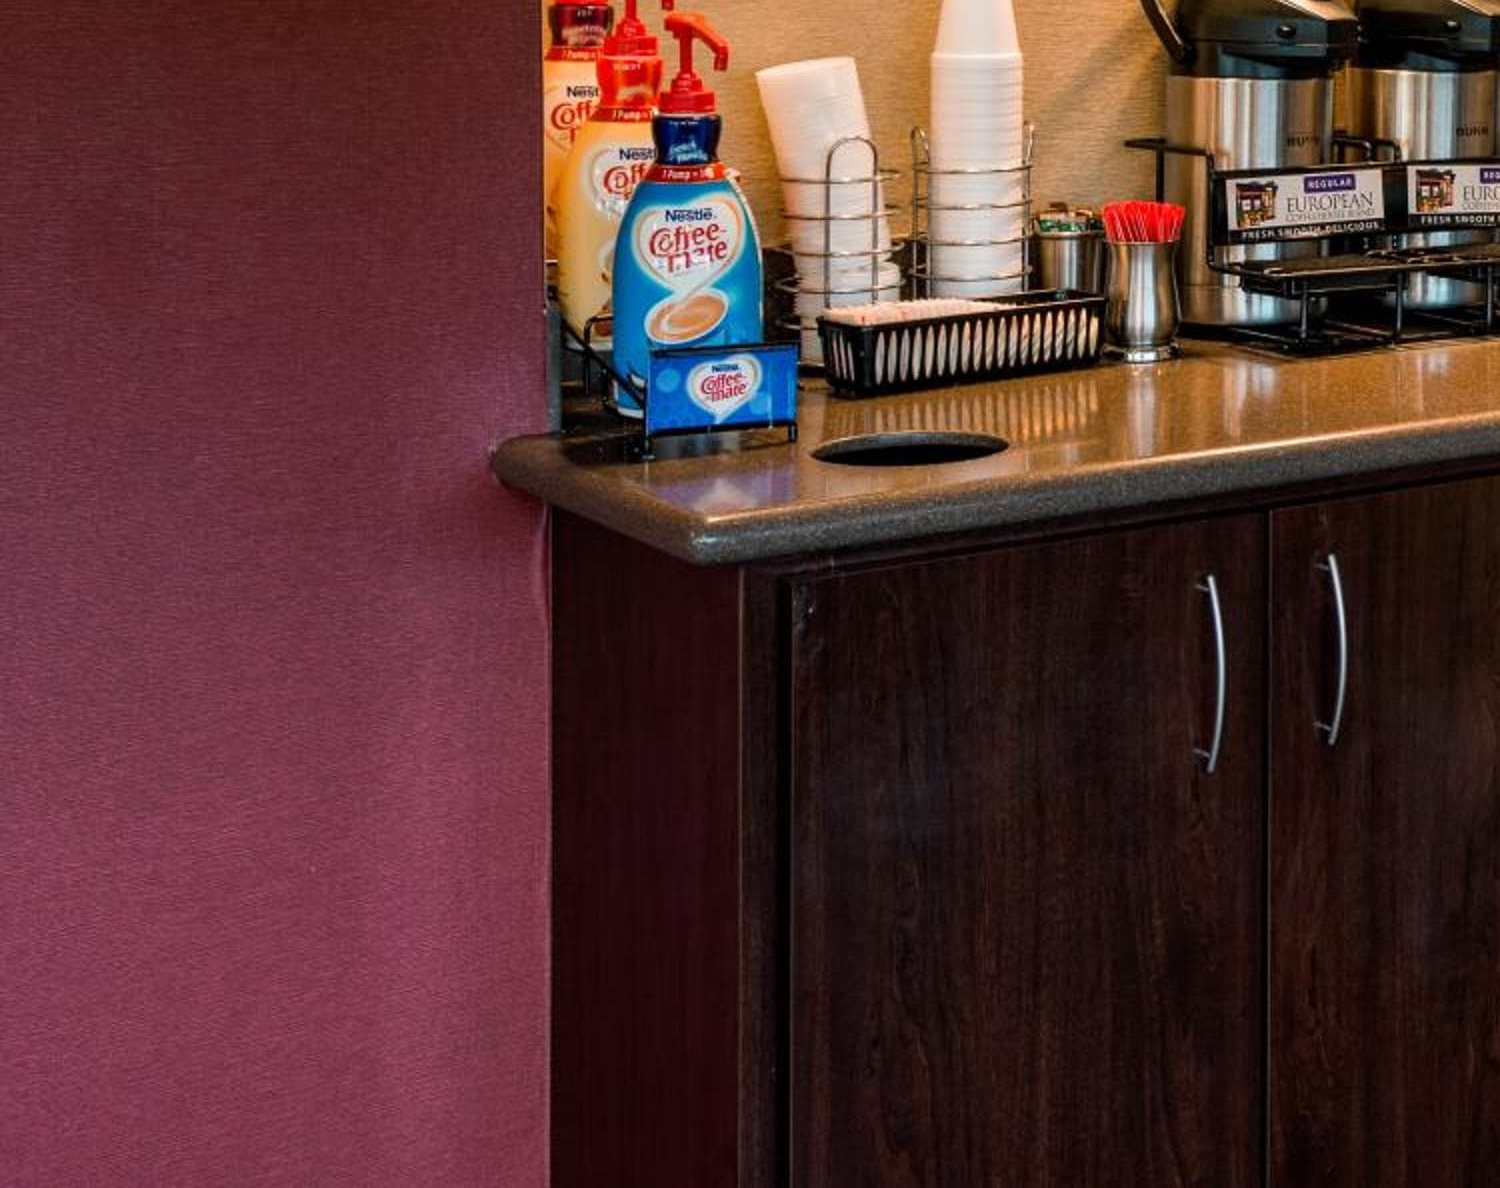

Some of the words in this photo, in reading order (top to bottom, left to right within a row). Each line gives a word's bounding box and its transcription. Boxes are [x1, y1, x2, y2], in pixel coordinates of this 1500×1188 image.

[567, 85, 599, 98] Nest
[551, 101, 593, 131] Coff
[619, 148, 658, 161] Nestl
[604, 163, 647, 196] Coff
[1307, 176, 1352, 190] REGULAR
[1286, 191, 1374, 213] EUROPEAN
[1421, 215, 1452, 224] FRESH
[1455, 214, 1496, 223] SMOOTH
[1241, 228, 1276, 240] FRESH
[711, 383, 747, 403] mate
